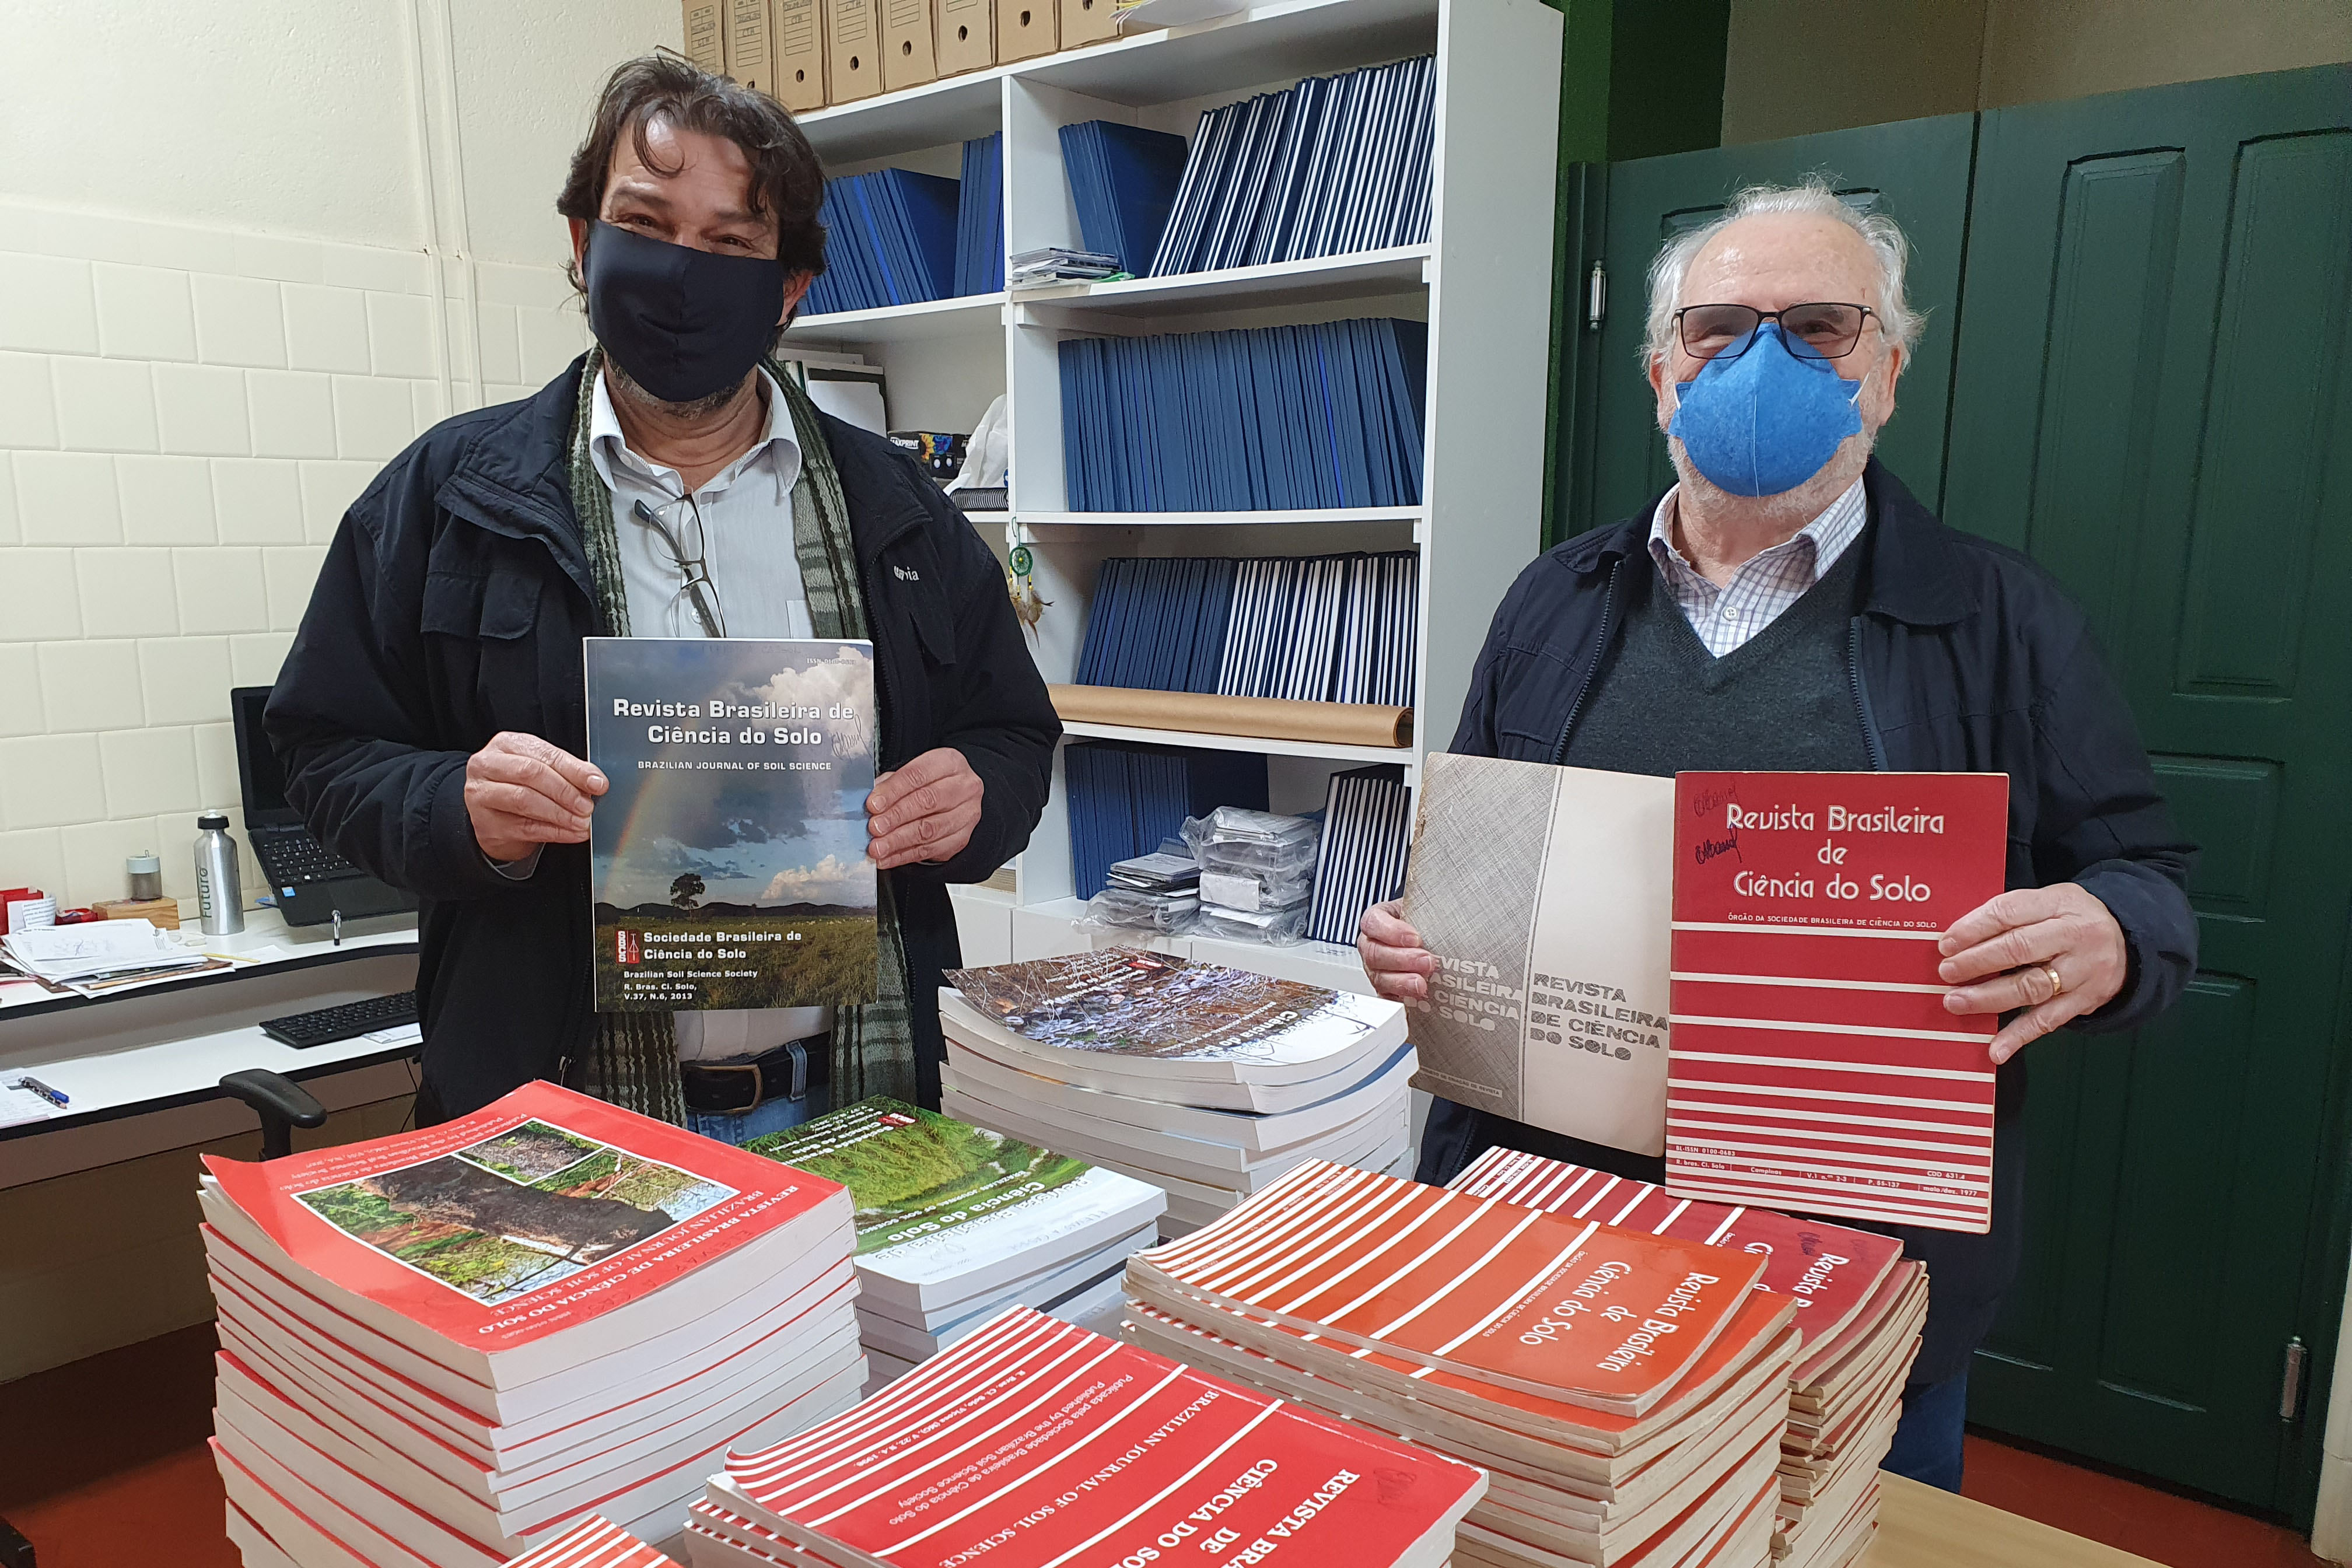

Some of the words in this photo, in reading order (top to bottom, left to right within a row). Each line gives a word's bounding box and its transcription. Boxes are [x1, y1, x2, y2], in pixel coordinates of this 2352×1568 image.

[614, 699, 701, 718] Revista
[709, 700, 821, 719] Brasileira
[829, 702, 854, 719] de
[648, 725, 731, 744] Ciência
[740, 727, 766, 744] do
[774, 727, 822, 745] Solo
[638, 761, 692, 769] BRAZILIAN
[696, 762, 744, 770] JOURNAL
[747, 762, 760, 770] OF
[764, 762, 786, 770] SOIL
[789, 762, 831, 771] SCIENCE
[1726, 803, 1815, 831] Revista
[1828, 804, 1944, 834] Brasileira
[1817, 838, 1848, 866] de
[1734, 870, 1814, 898] Ciência
[1826, 873, 1860, 900] do
[1870, 874, 1931, 902] Solo
[1728, 912, 1753, 921] ÓRGÃO
[1869, 917, 1900, 926] CIÊNCIA
[644, 932, 712, 943] Sociedade
[716, 932, 782, 942] Brasileira
[787, 931, 802, 941] de
[644, 949, 692, 960] Ciência
[697, 949, 713, 960] do
[718, 948, 746, 959] Solo
[724, 970, 758, 978] Society
[1436, 956, 1499, 979] VISTA
[624, 993, 647, 1001] V.37,
[675, 983, 697, 991] Solo,
[1534, 973, 1626, 1002] REVISTA
[1531, 991, 1668, 1031] BRASILEIRA
[1531, 1010, 1561, 1028] DE
[1240, 1011, 1298, 1042] Ciência
[1530, 1027, 1562, 1045] DO
[1568, 1035, 1632, 1060] SOLO
[738, 1185, 799, 1218] REVISTA
[969, 1181, 1045, 1213] Ciência
[939, 1210, 967, 1223] do
[653, 1217, 741, 1262] BRASILEIRA
[887, 1222, 941, 1242] Solo
[627, 1261, 654, 1275] DE
[1572, 1261, 1632, 1298] Ciência
[1792, 1253, 1850, 1294] Revista
[556, 1273, 627, 1306] CIÊNCIA
[1654, 1272, 1721, 1317] Revista
[529, 1303, 556, 1317] DO
[1553, 1300, 1591, 1317] do
[1600, 1305, 1637, 1322] de
[479, 1315, 527, 1334] SOLO
[1519, 1317, 1573, 1345] Solo
[1596, 1318, 1679, 1372] Brasileira
[1060, 1381, 1105, 1414] Published
[1090, 1374, 1133, 1405] Publicada
[1049, 1410, 1063, 1423] by
[1070, 1403, 1091, 1419] pela
[1143, 1390, 1220, 1449] BRAZILIAN
[1025, 1418, 1073, 1450] Sociedade
[1034, 1420, 1051, 1433] the
[995, 1430, 1037, 1455] Brazilian
[975, 1454, 997, 1467] Soil
[982, 1448, 1028, 1475] Brasileira
[1074, 1443, 1150, 1492] JOURNAL
[937, 1465, 978, 1488] Science
[968, 1473, 982, 1484] de
[898, 1485, 939, 1510] Society
[929, 1482, 969, 1504] Ciência
[1055, 1490, 1078, 1508] OF
[1189, 1458, 1279, 1524] CIÊNCIA
[1266, 1468, 1360, 1537] REVISTA
[889, 1510, 916, 1525] Solo
[915, 1502, 930, 1513] do
[1013, 1504, 1055, 1529] SOIL
[1157, 1520, 1198, 1548] DO
[1199, 1527, 1241, 1554] DE
[939, 1528, 1016, 1568] SCIENCE
